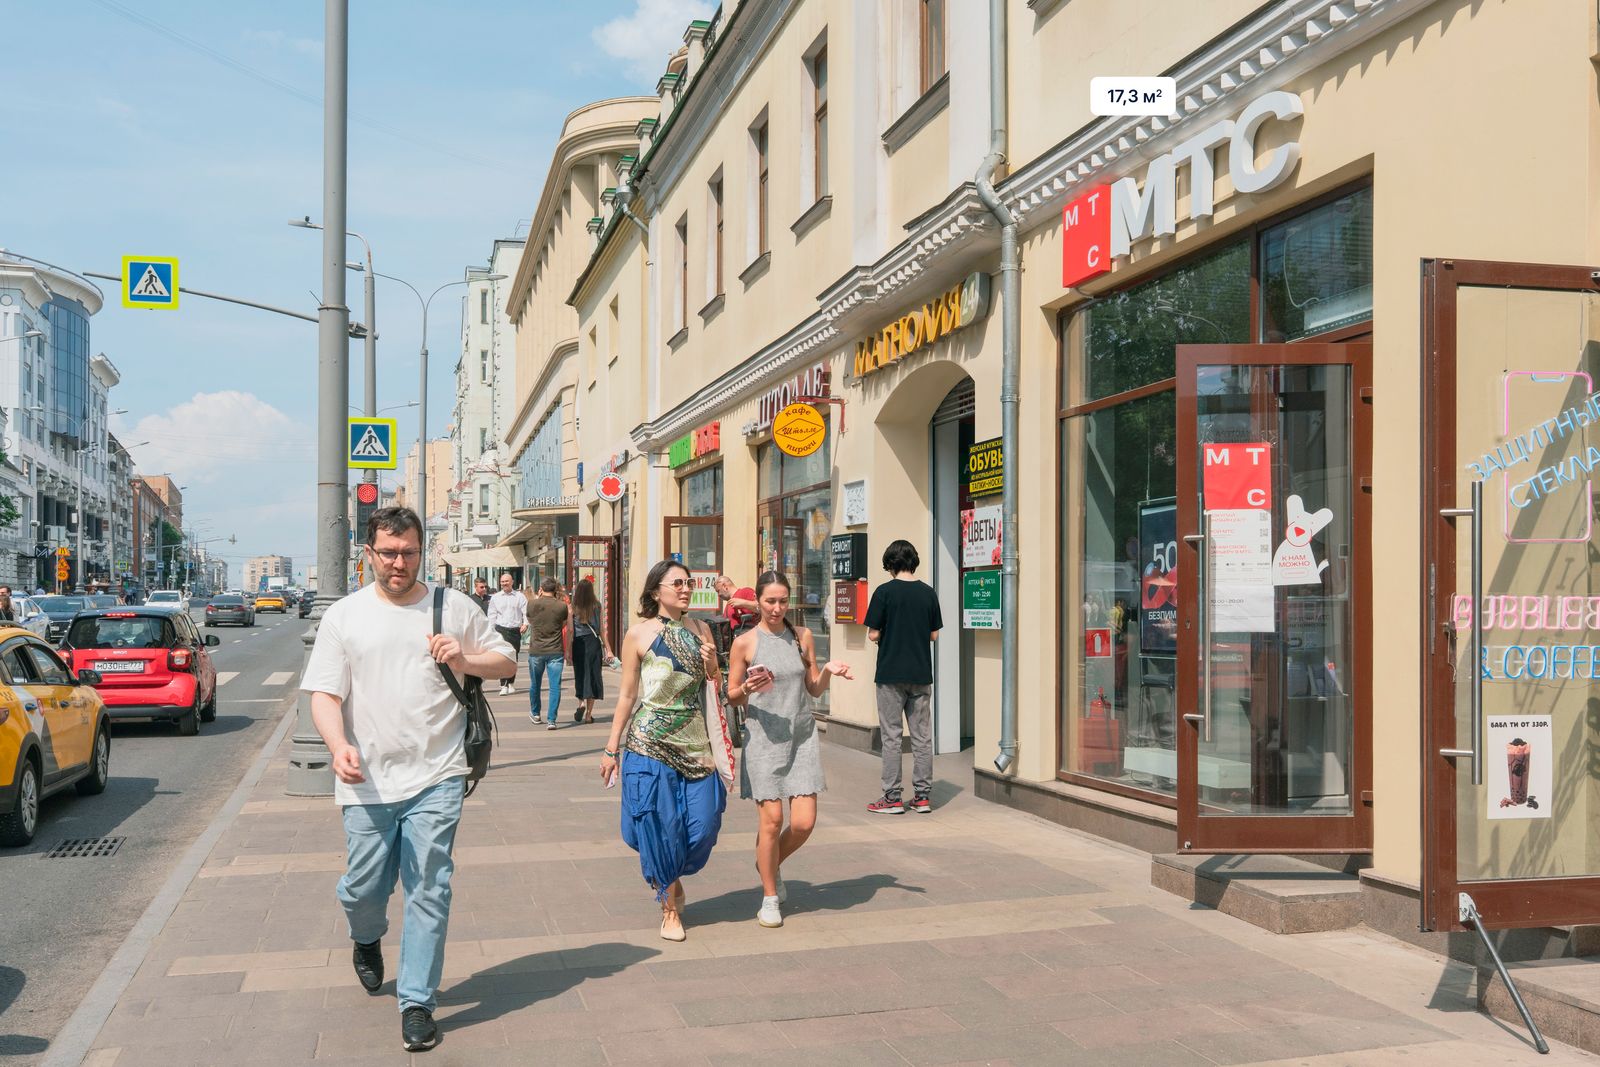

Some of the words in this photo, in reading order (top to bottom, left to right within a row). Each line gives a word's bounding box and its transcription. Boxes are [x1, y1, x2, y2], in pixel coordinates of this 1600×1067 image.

[1110, 90, 1304, 258] МТС
[854, 285, 962, 378] МАГНОЛИЯ
[960, 280, 979, 316] 24
[785, 406, 811, 417] кафе
[786, 440, 817, 454] пироги
[1464, 389, 1600, 482] ЗАЩИТНЫЕ
[970, 448, 1003, 473] ОБУВЬ
[1510, 446, 1600, 508] СТЕКЛА
[527, 496, 556, 507] БИЗНЕС
[968, 518, 996, 545] ЦВЕТЫ
